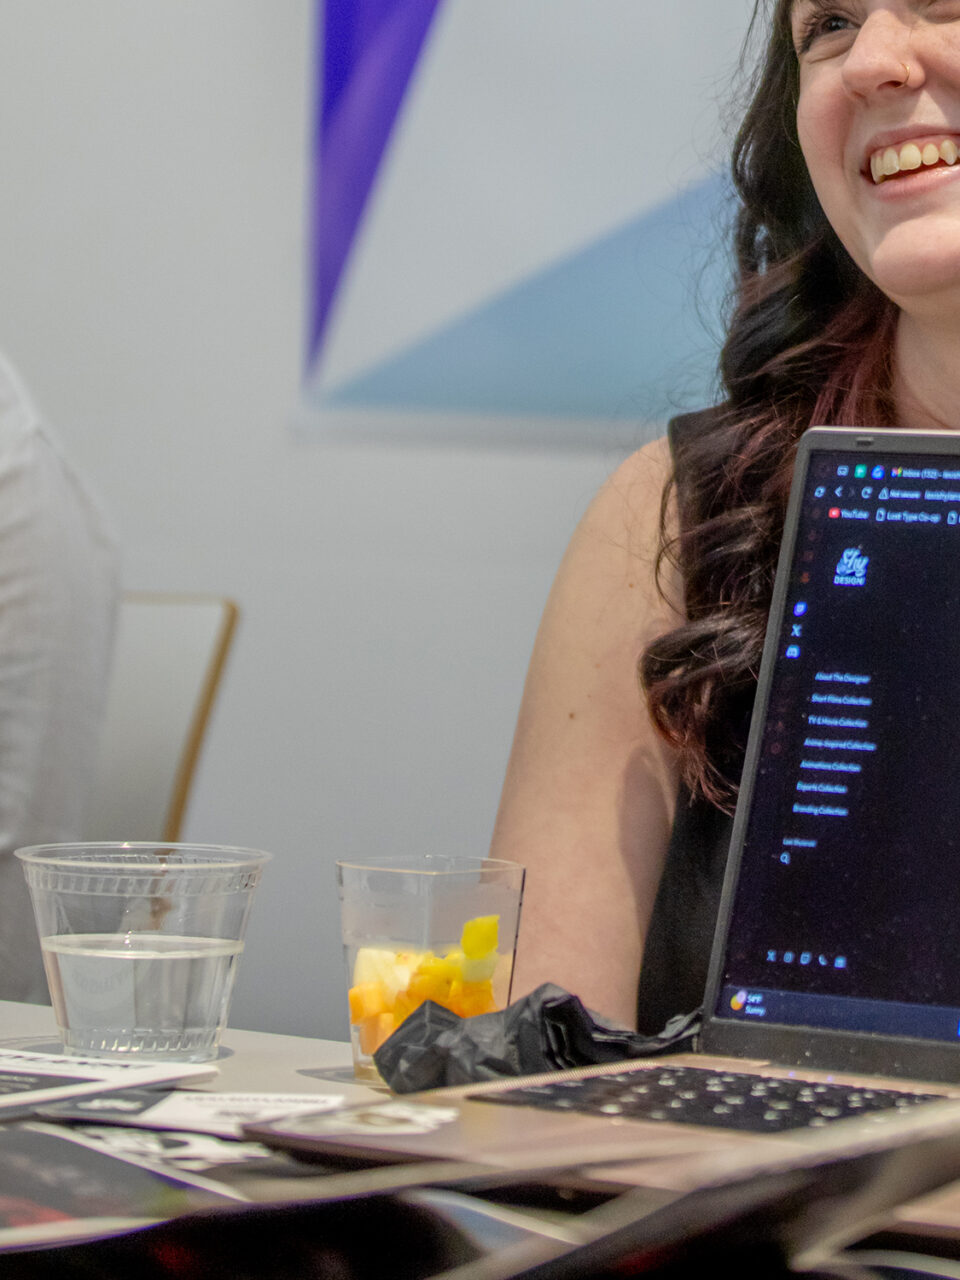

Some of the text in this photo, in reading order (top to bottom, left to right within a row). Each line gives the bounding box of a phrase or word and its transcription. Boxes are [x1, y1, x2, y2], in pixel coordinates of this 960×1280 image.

[840, 509, 869, 519] YouTube
[833, 575, 866, 586] DESIGN
[815, 672, 832, 681] About
[844, 673, 871, 684] Designer
[842, 696, 872, 706] Collection
[839, 718, 868, 728] Collection
[846, 740, 876, 751] Collection
[832, 762, 862, 773] Collection
[817, 783, 848, 794] Collection
[818, 805, 848, 816] Collection
[745, 1005, 766, 1017] Sunny
